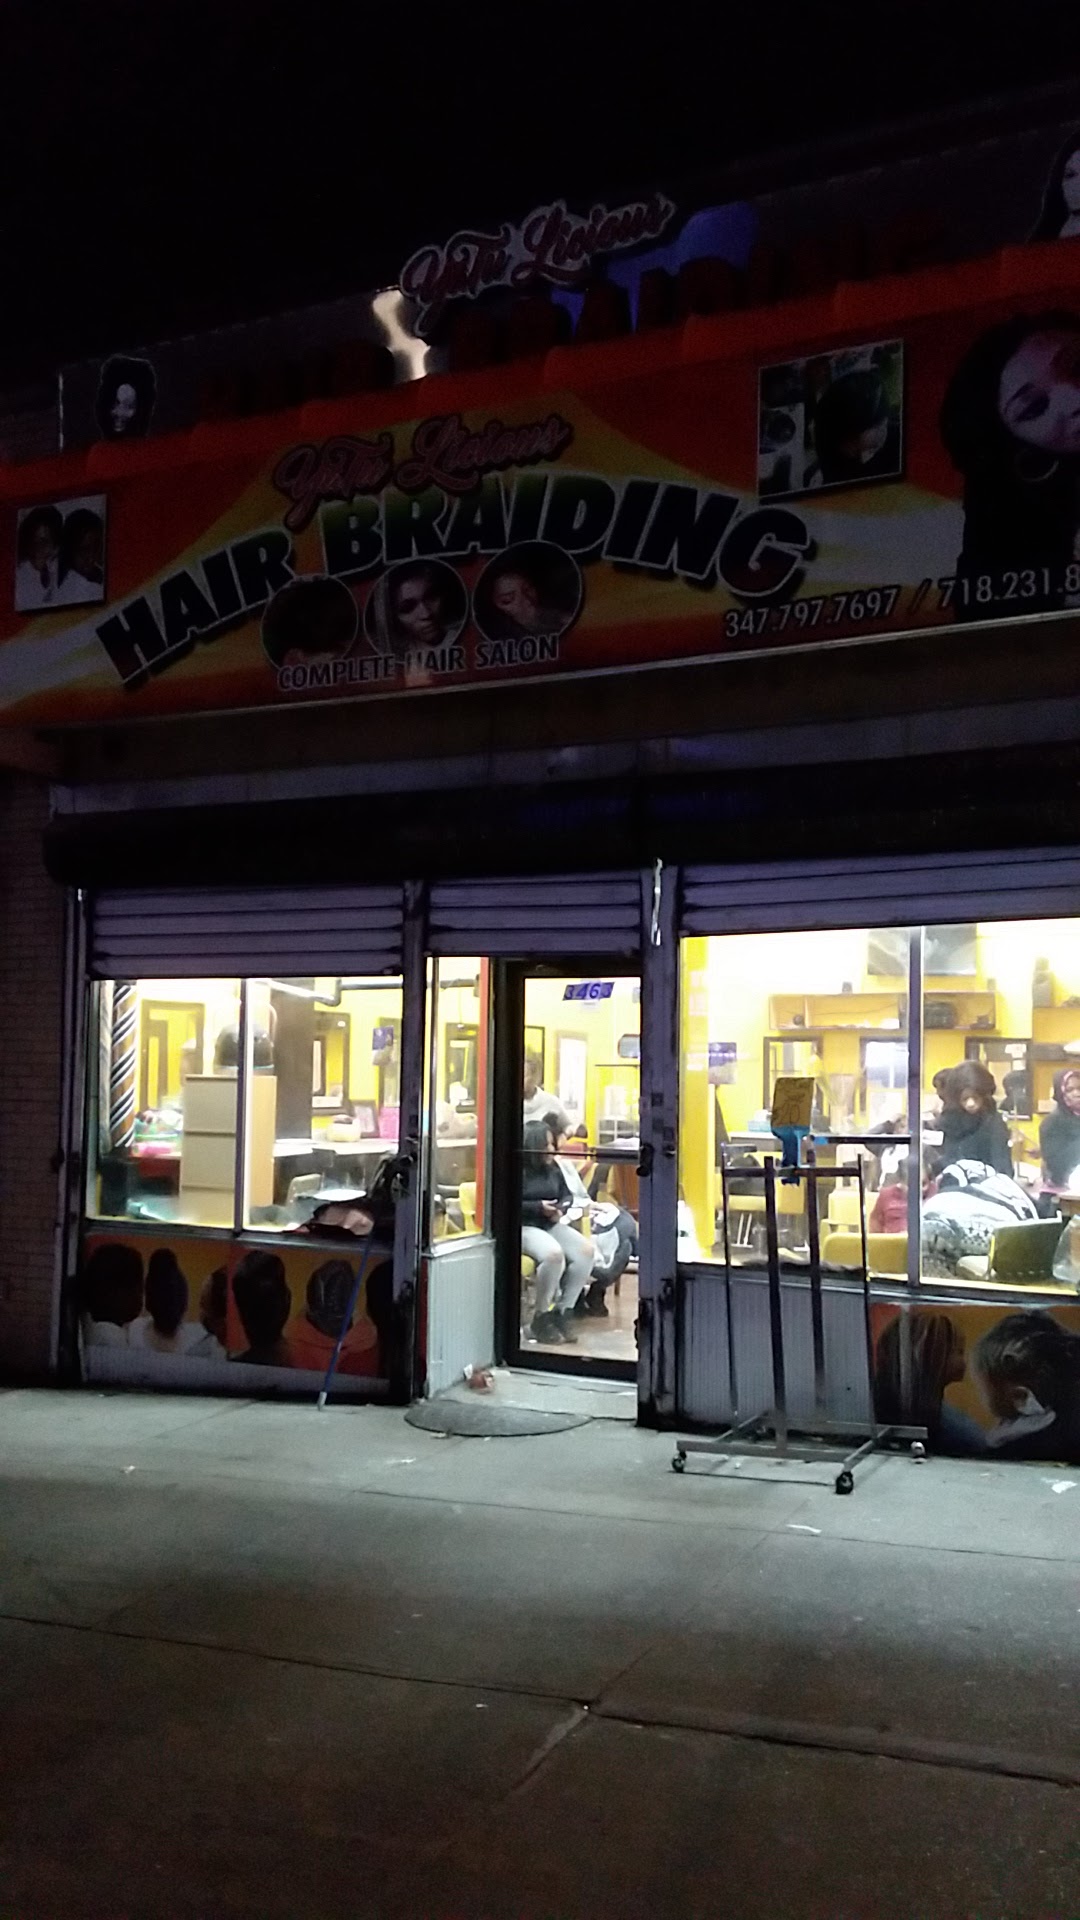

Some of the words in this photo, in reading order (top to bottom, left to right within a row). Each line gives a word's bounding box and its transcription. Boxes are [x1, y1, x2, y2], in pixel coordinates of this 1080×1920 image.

[97, 528, 298, 684] HAIR
[317, 470, 811, 598] BRAIDING
[724, 586, 900, 639] 347.797.7697
[278, 655, 397, 692] COMPLETE
[405, 643, 466, 677] HAIR
[475, 632, 560, 670] SALON
